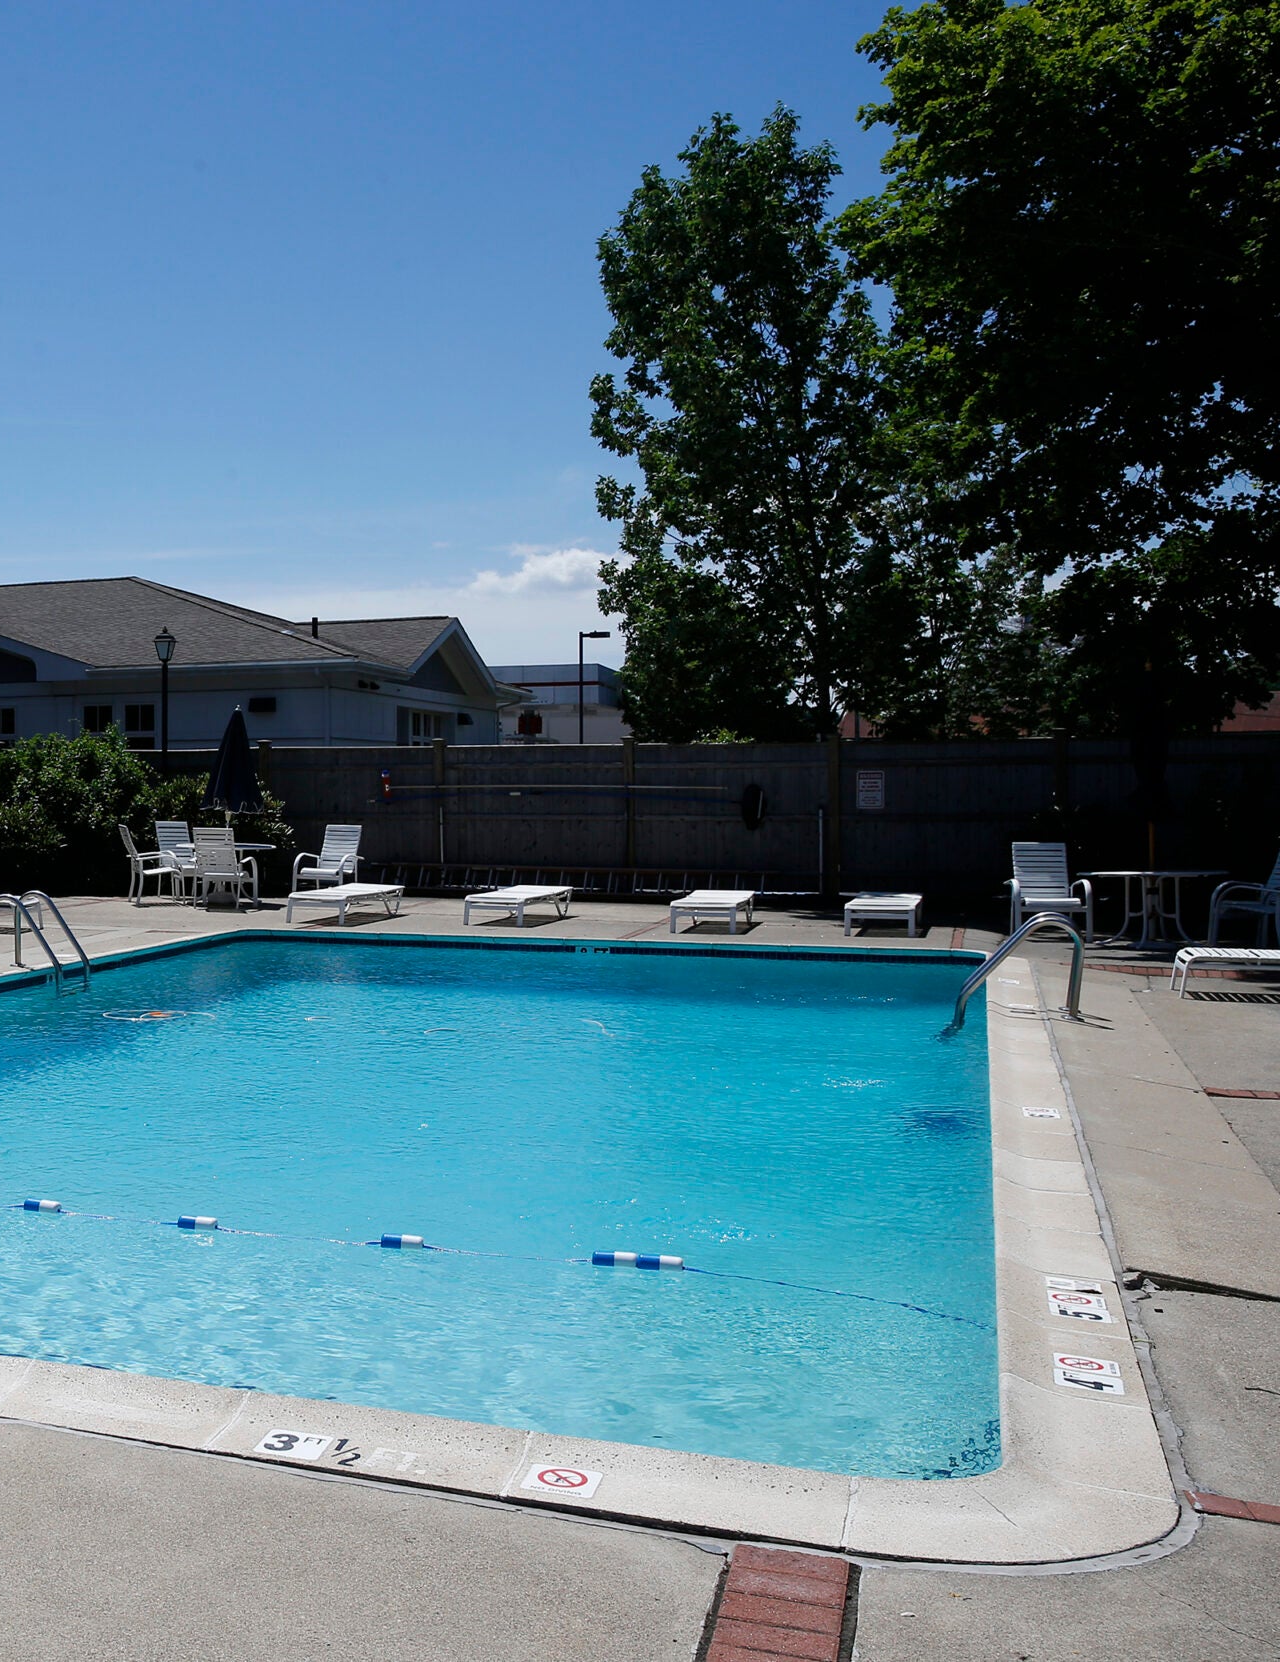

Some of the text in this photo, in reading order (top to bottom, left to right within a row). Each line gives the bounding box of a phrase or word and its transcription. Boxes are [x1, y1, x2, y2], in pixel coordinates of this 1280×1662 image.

[1059, 1309, 1103, 1320] 5
[1064, 1378, 1114, 1391] 4
[263, 1433, 300, 1451] 3
[303, 1437, 327, 1446] FT
[548, 1487, 582, 1496] DIVING
